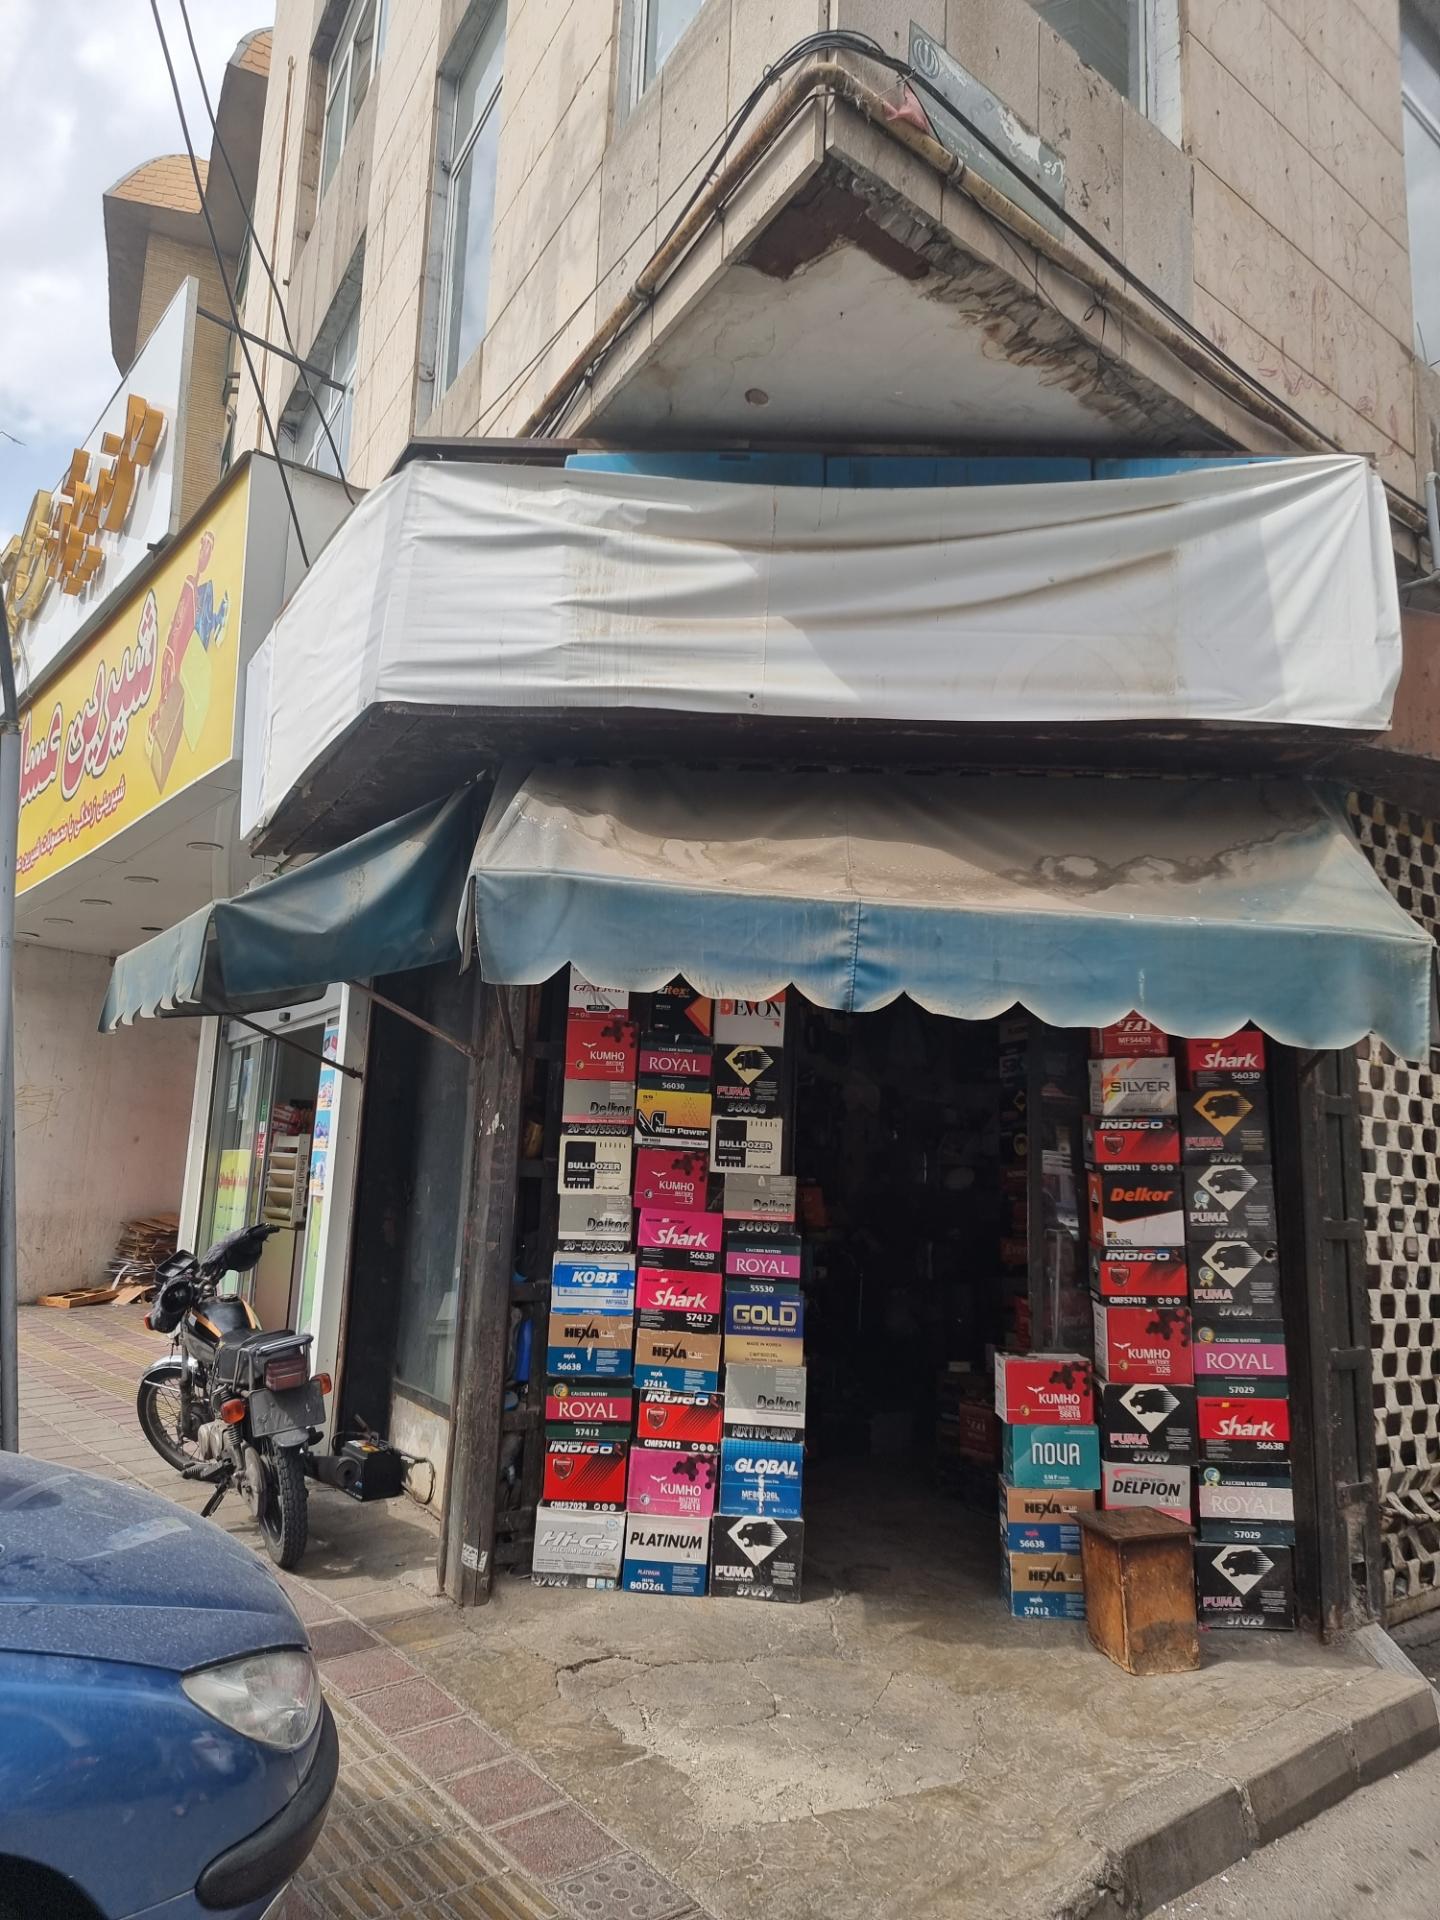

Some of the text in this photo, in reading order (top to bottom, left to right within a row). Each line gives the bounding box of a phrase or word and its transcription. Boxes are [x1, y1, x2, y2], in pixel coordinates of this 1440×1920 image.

[62, 588, 158, 801] شیرین
[720, 999, 781, 1017] DEVON
[590, 1051, 625, 1061] KUMHO
[1200, 1048, 1260, 1068] Shark
[650, 1057, 700, 1073] ROYAL
[1232, 1072, 1260, 1080] 56030
[662, 1082, 685, 1090] 56030
[717, 1085, 751, 1096] PUMA
[1110, 1081, 1170, 1092] SILVER
[590, 1101, 632, 1116] Delkor
[655, 1126, 708, 1136] Nice Power
[1100, 1121, 1164, 1130] INDIGO
[719, 1140, 772, 1150] BULLDOZER
[567, 1162, 621, 1170] BULLDOZER
[659, 1180, 695, 1191] KUMHO
[1110, 1187, 1174, 1202] Delkor
[752, 1198, 791, 1213] Delkor
[1189, 1212, 1229, 1222] PUMA
[586, 1217, 630, 1232] Delkor
[739, 1222, 779, 1233] 56030
[651, 1226, 711, 1248] Shark
[689, 1251, 714, 1260] 56638
[1106, 1253, 1170, 1261] INDIGO
[736, 1258, 789, 1275] ROYAL
[572, 1271, 618, 1284] KOBA
[750, 1284, 774, 1293] 55530
[1193, 1288, 1233, 1300] PUMA
[648, 1286, 709, 1309] Shark
[686, 1313, 713, 1323] 57412
[733, 1304, 797, 1327] GOLD
[1128, 1349, 1171, 1359] KUMHO
[557, 1362, 582, 1371] 56638
[1206, 1352, 1274, 1370] ROYAL
[644, 1379, 668, 1388] 57412
[1228, 1386, 1255, 1394] 57029
[645, 1393, 709, 1406] INDIGO
[756, 1395, 802, 1412] Delkor
[1038, 1393, 1080, 1405] KUMHO
[559, 1401, 618, 1419] ROYAL
[575, 1428, 600, 1436] 57412
[1212, 1414, 1276, 1438] Shark
[644, 1439, 681, 1450] CMF57412
[1109, 1433, 1150, 1445] PUMA
[549, 1444, 613, 1454] INDIGO
[1256, 1441, 1284, 1450] 56638
[734, 1457, 799, 1476] GLOBAL
[660, 1483, 701, 1497] KUMHO
[1112, 1480, 1181, 1497] DELPION
[1211, 1495, 1281, 1515] ROYAL
[630, 1531, 703, 1550] PLATINUM
[1234, 1530, 1261, 1539] 57029
[540, 1531, 619, 1552] Hi-Ca
[1019, 1540, 1045, 1548] 56638
[715, 1565, 754, 1578] PUMA
[1202, 1596, 1243, 1608] PUMA
[1024, 1607, 1049, 1616] 57412
